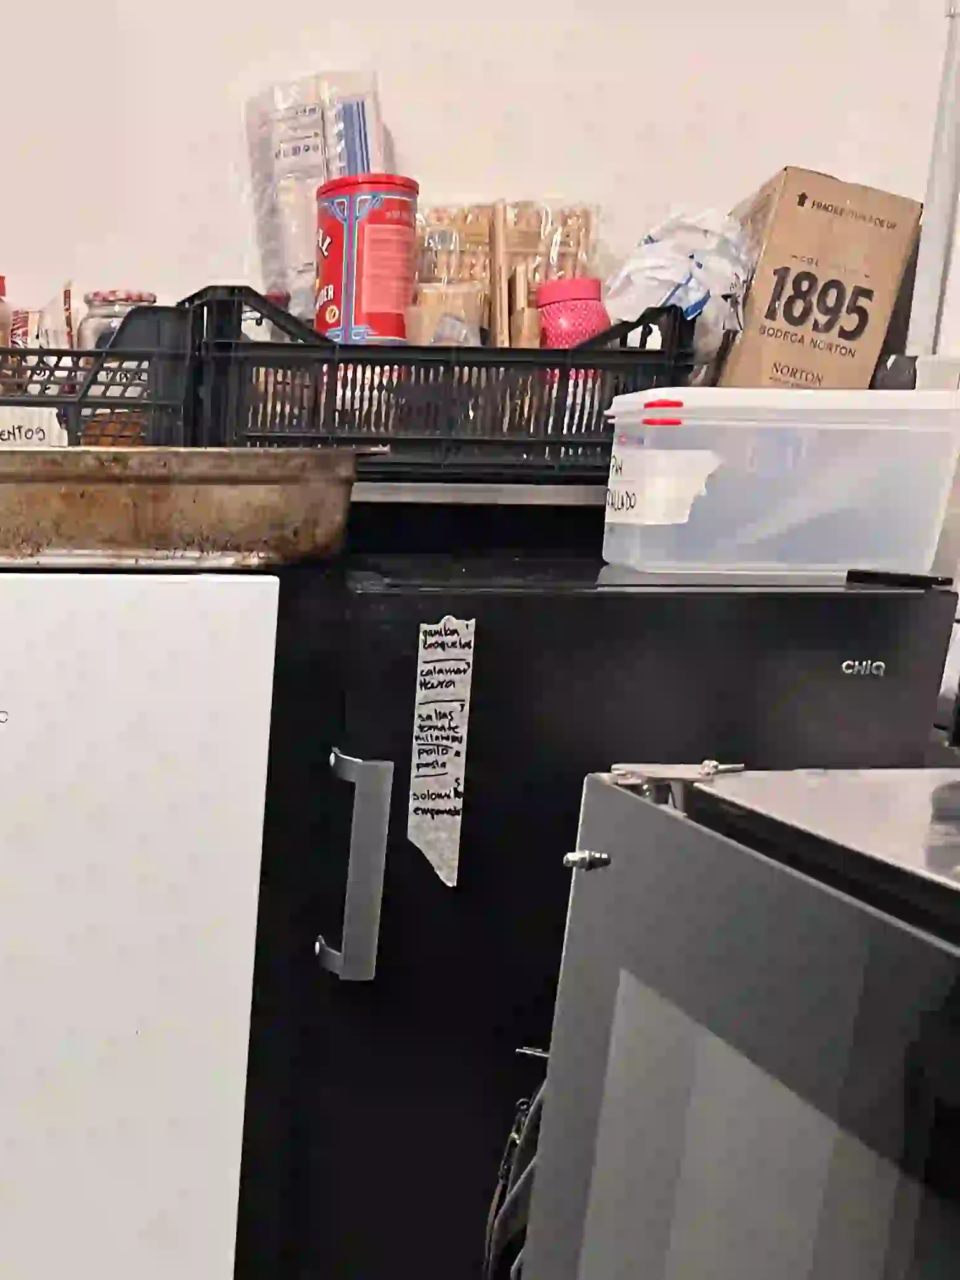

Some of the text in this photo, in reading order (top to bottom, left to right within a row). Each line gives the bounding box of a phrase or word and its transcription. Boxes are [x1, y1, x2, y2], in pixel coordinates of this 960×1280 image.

[764, 266, 875, 342] 1895
[759, 324, 857, 359] BODEGA NORTON
[771, 361, 824, 387] NORTON
